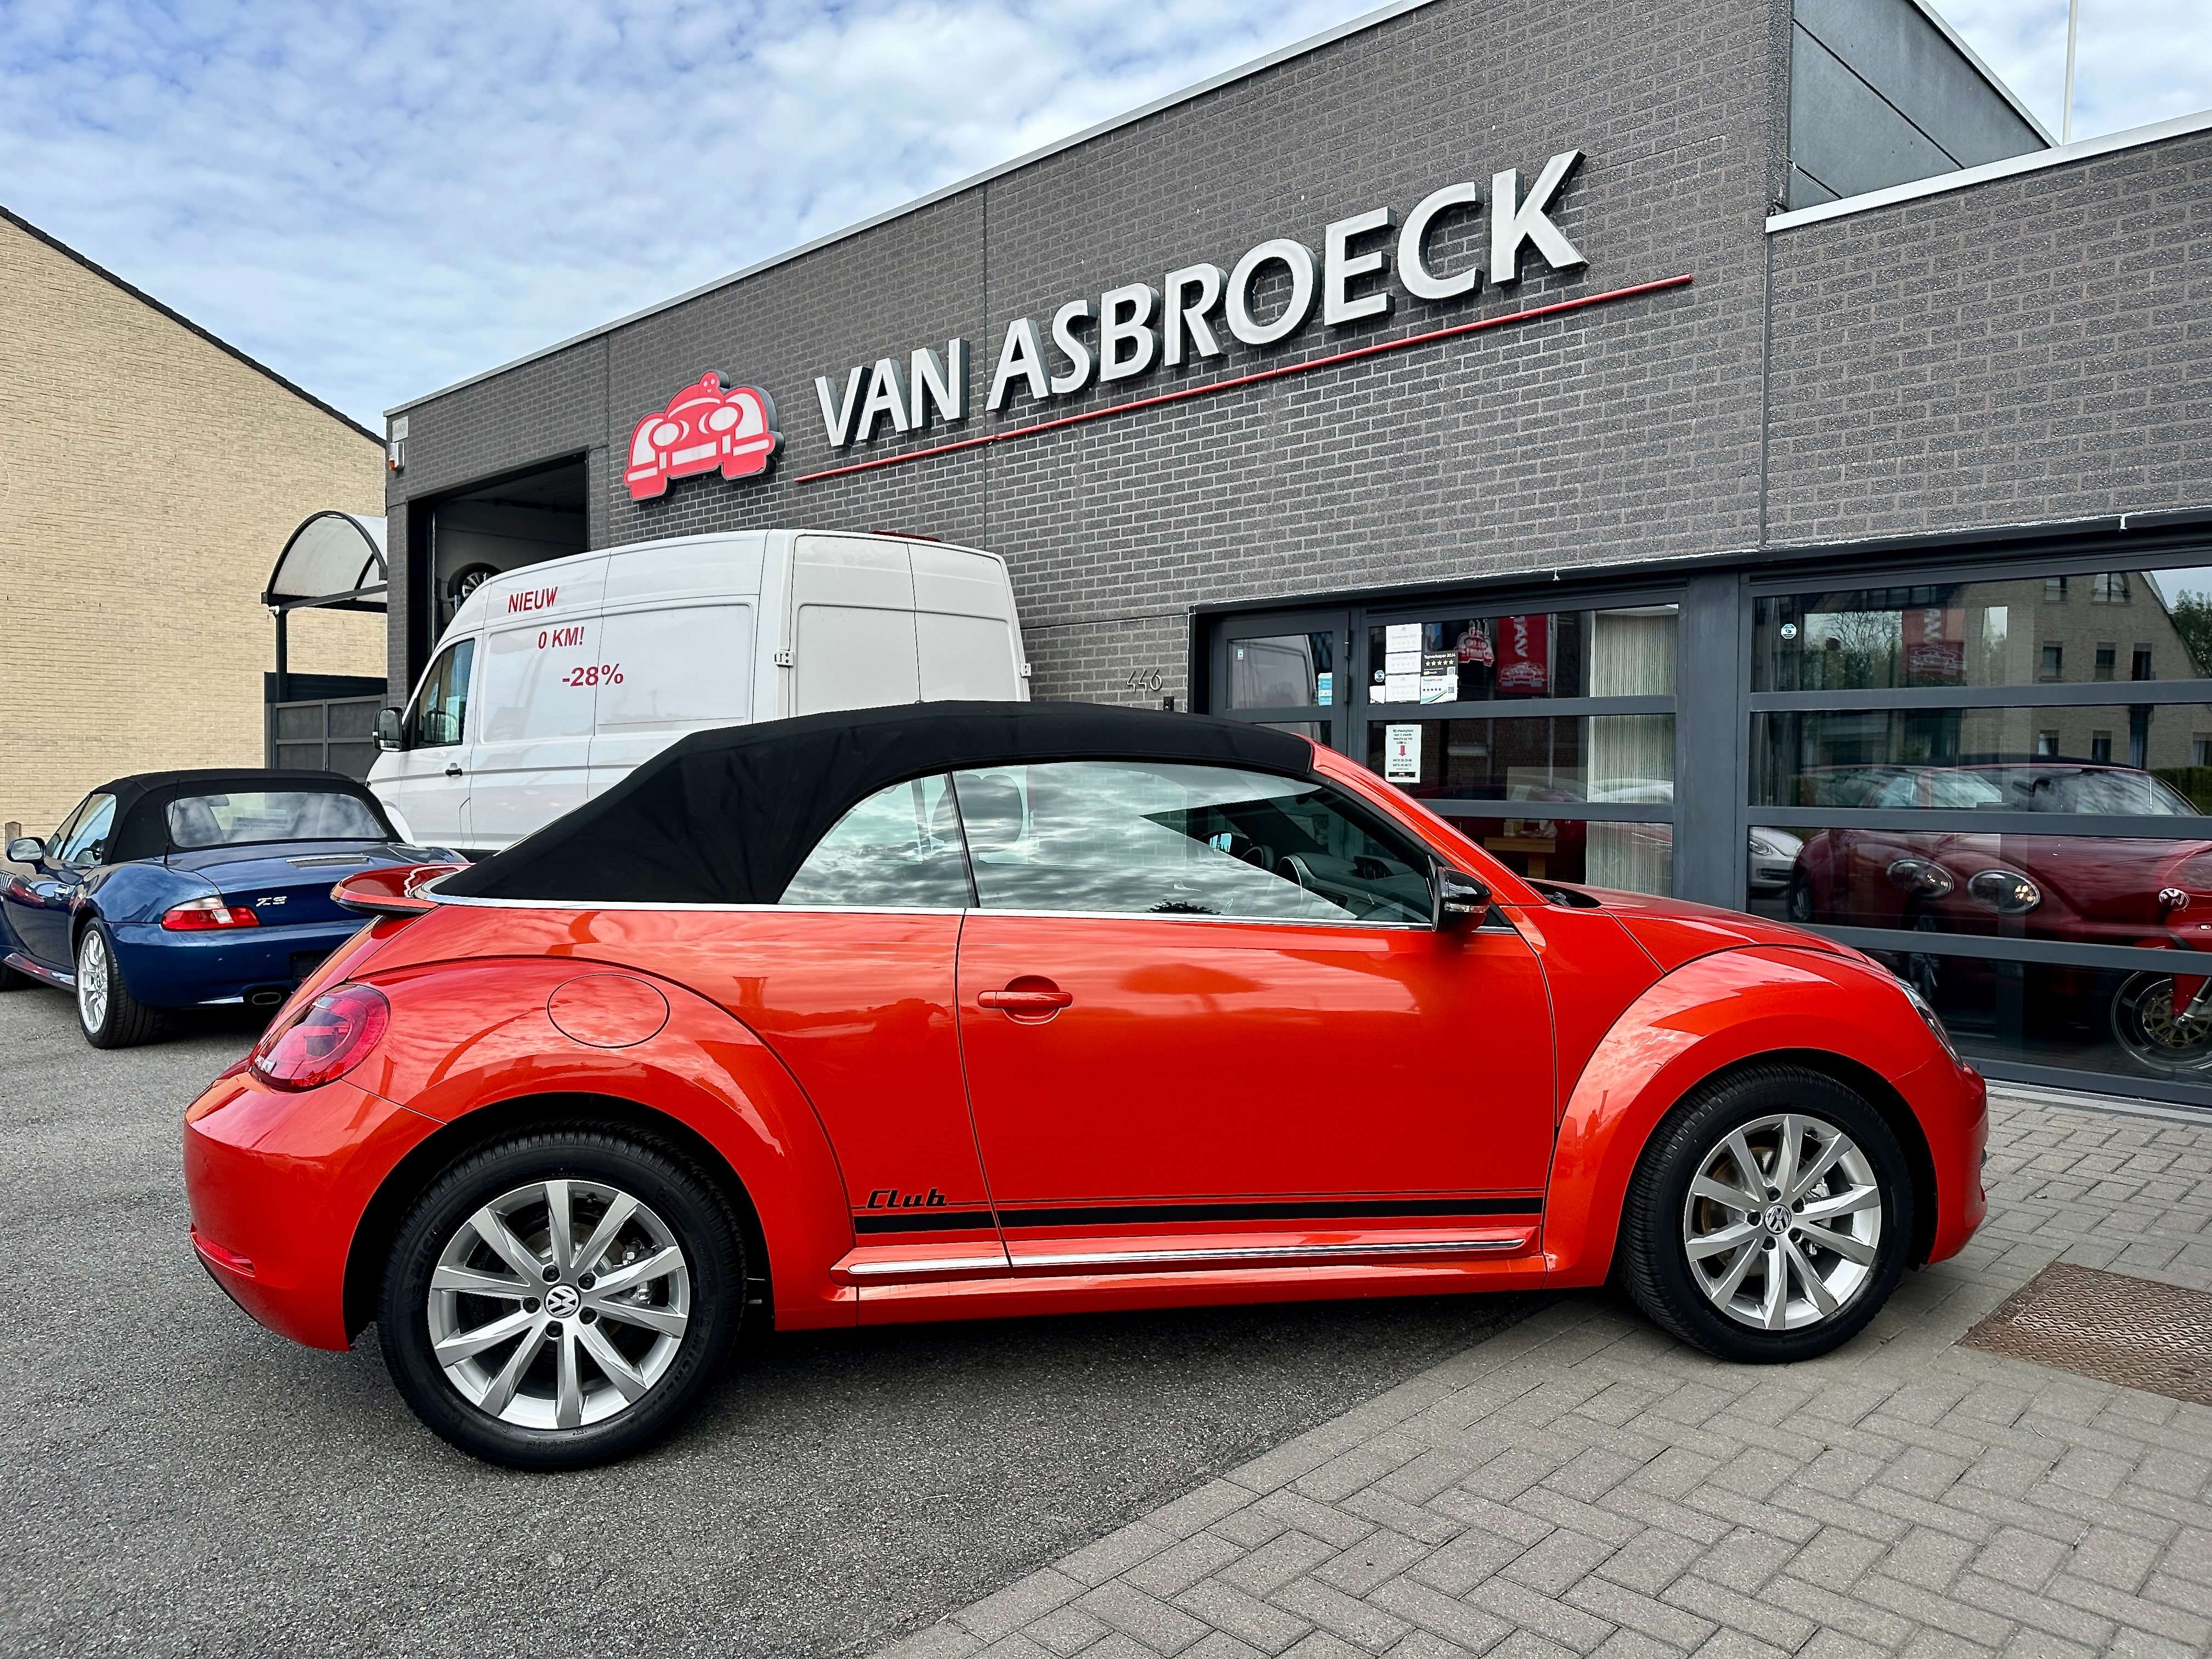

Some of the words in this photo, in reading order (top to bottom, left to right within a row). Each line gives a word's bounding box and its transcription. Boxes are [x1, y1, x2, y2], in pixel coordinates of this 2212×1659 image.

[814, 337, 970, 447] VAN
[985, 148, 1589, 412] ASBROECK
[508, 586, 558, 613] NIEUW
[538, 630, 546, 650] 0
[551, 627, 584, 648] KM!
[562, 663, 624, 687] -28%
[1126, 668, 1163, 692] 446
[866, 1188, 948, 1209] Club
